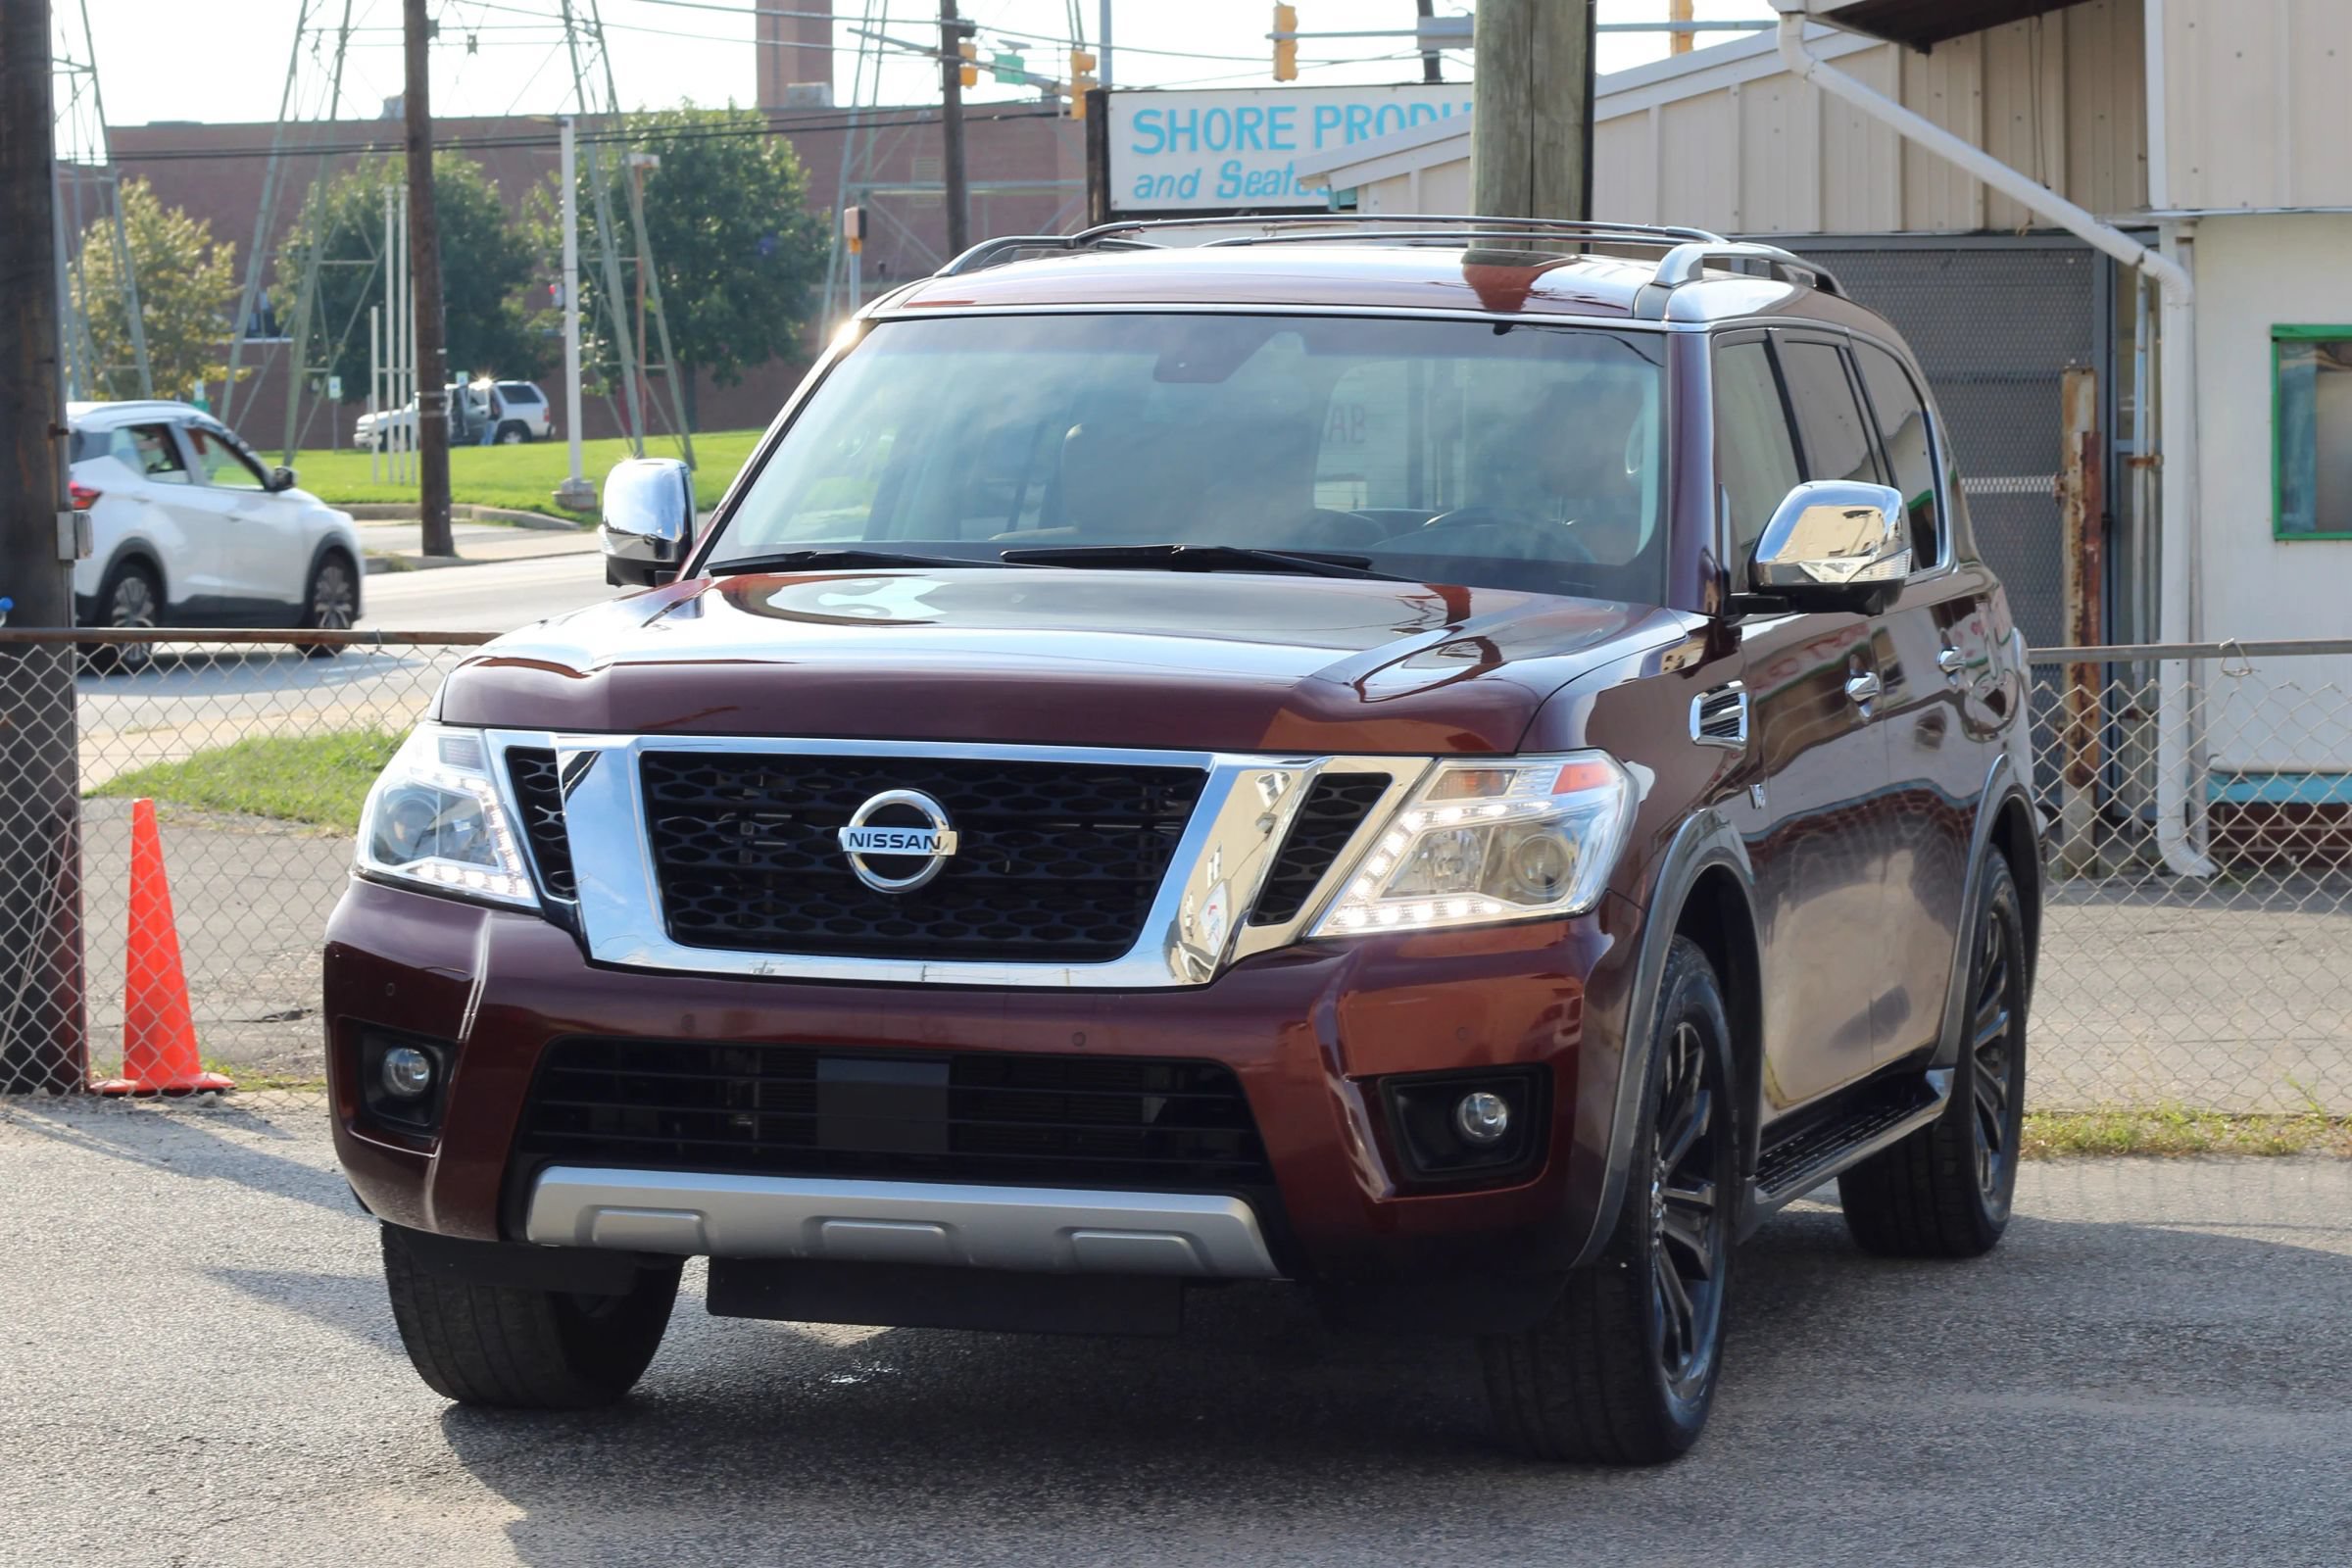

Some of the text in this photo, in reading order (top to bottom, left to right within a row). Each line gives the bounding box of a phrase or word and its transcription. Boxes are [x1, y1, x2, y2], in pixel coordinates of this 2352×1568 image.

[1131, 105, 1298, 156] SHORE
[1133, 167, 1202, 200] and
[849, 832, 941, 850] NISSAN
